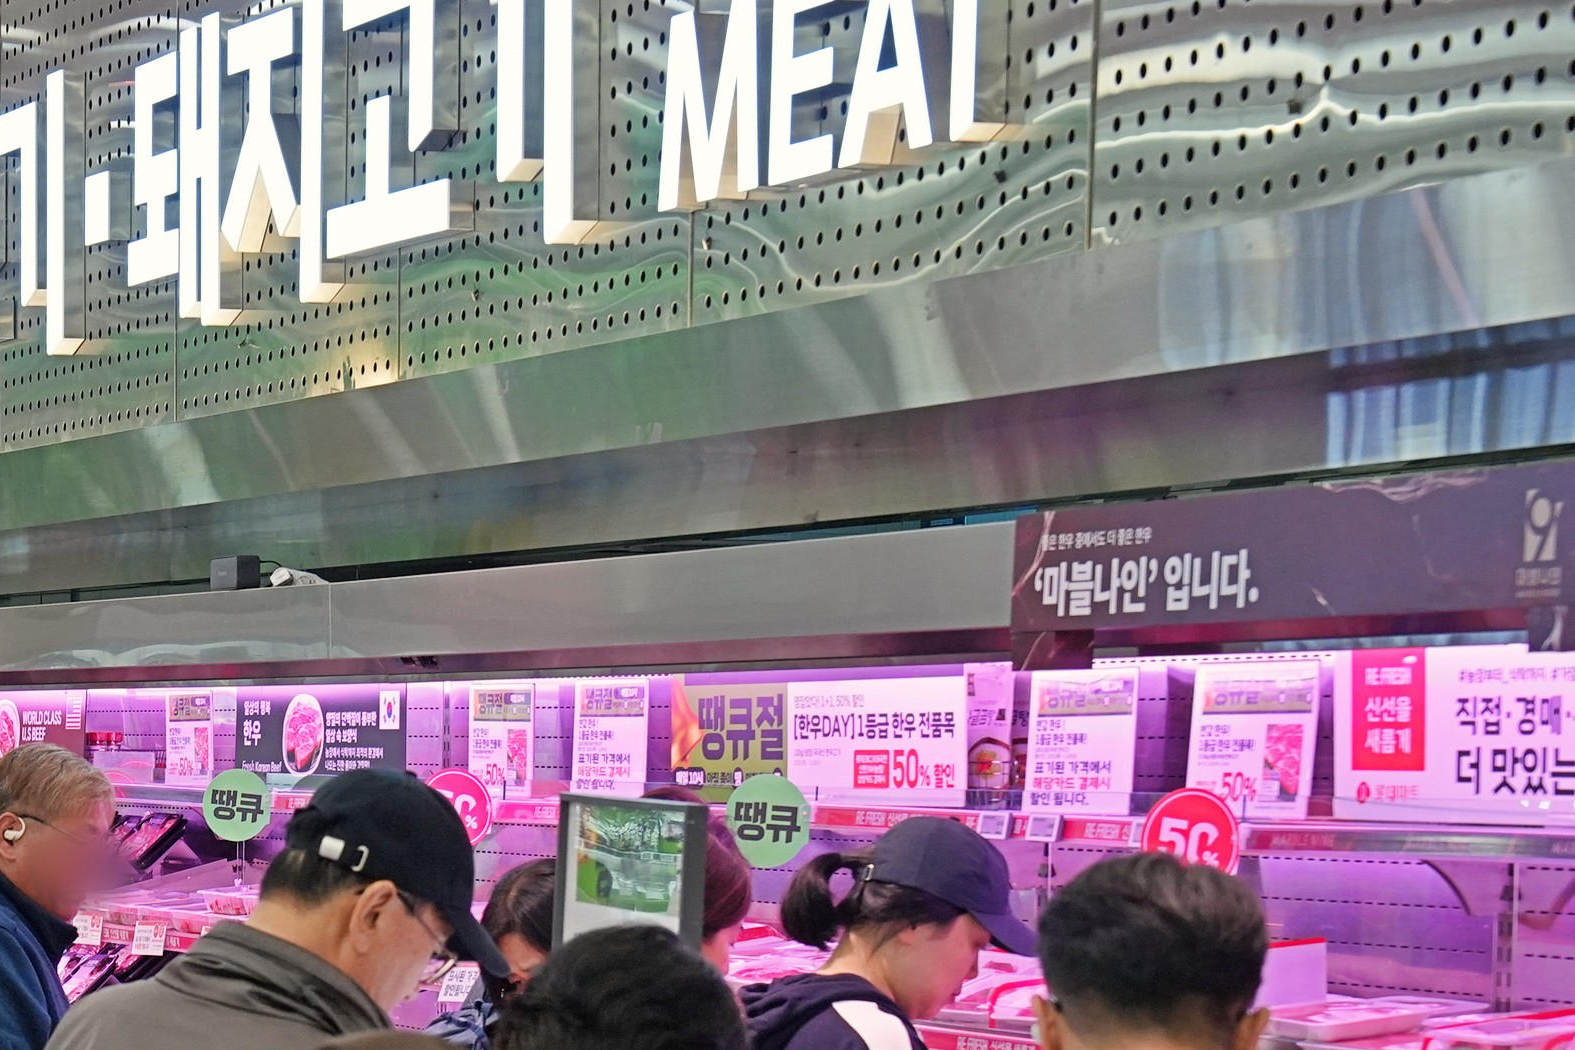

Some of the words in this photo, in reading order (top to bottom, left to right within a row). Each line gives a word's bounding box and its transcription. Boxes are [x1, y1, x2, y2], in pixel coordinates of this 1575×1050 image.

[1107, 529, 1117, 546] 더
[1117, 528, 1134, 546] 좋은
[1135, 527, 1152, 544] 한우
[1163, 548, 1259, 611] 입니다.
[23, 711, 43, 725] WORLD
[44, 711, 62, 725] CLASS
[244, 700, 259, 716] 일상의
[260, 700, 271, 716] 행복
[1364, 695, 1412, 722] 신선을
[32, 727, 46, 741] BEEF
[243, 720, 261, 746] 한우
[698, 693, 784, 761] 땡큐절
[794, 713, 854, 740] [한우DAY]
[858, 713, 889, 739] 1등급
[892, 712, 916, 739] 한우
[919, 712, 955, 739] 전품목
[1364, 727, 1412, 755] 새롭게
[271, 761, 282, 773] Beef
[578, 754, 598, 764] 표기된
[601, 753, 630, 764] 가격에서
[893, 748, 930, 789] 50%
[934, 764, 955, 789] 할인
[1035, 761, 1065, 774] 표기된
[1068, 761, 1111, 774] 가격에서
[485, 763, 505, 785] 50%
[577, 766, 606, 776] 해당카드
[608, 766, 630, 777] 결제시
[689, 771, 704, 785] 10시
[1456, 747, 1480, 795] 더
[1492, 747, 1575, 795] 맛있는
[1033, 777, 1074, 789] 해당카드
[1079, 777, 1110, 789] 결제시
[1221, 772, 1256, 801] 50%
[1375, 785, 1419, 801] 롯데마트
[210, 788, 264, 824] 땡큐
[1031, 793, 1050, 805] 할인
[1053, 793, 1089, 806] 됩니다.
[734, 801, 801, 843] 땡큐
[1158, 816, 1220, 866] 50%
